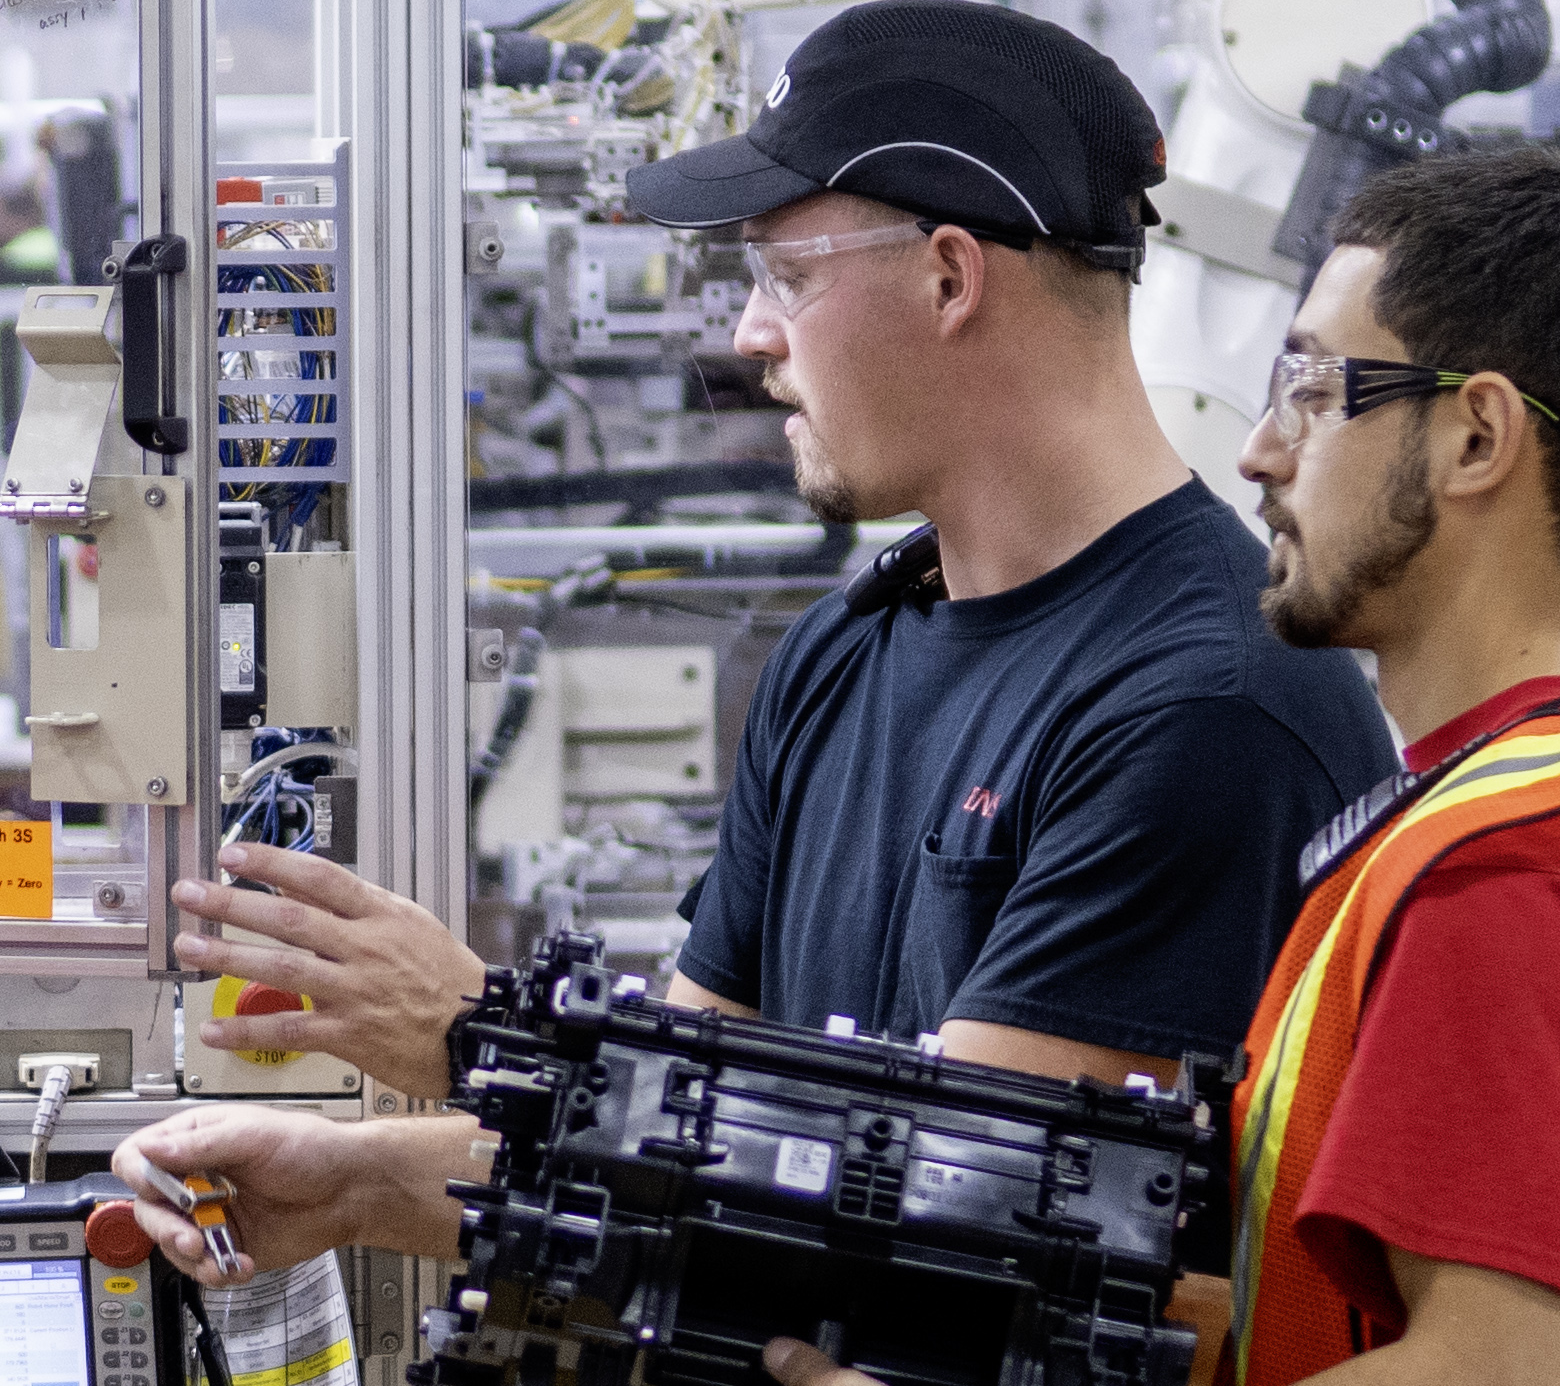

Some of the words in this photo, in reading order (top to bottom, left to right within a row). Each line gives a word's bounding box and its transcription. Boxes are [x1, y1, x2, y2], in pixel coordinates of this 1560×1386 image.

[13, 829, 32, 843] 3S
[17, 878, 42, 888] Zero
[255, 1050, 286, 1063] STOP
[111, 1281, 131, 1290] STOP
